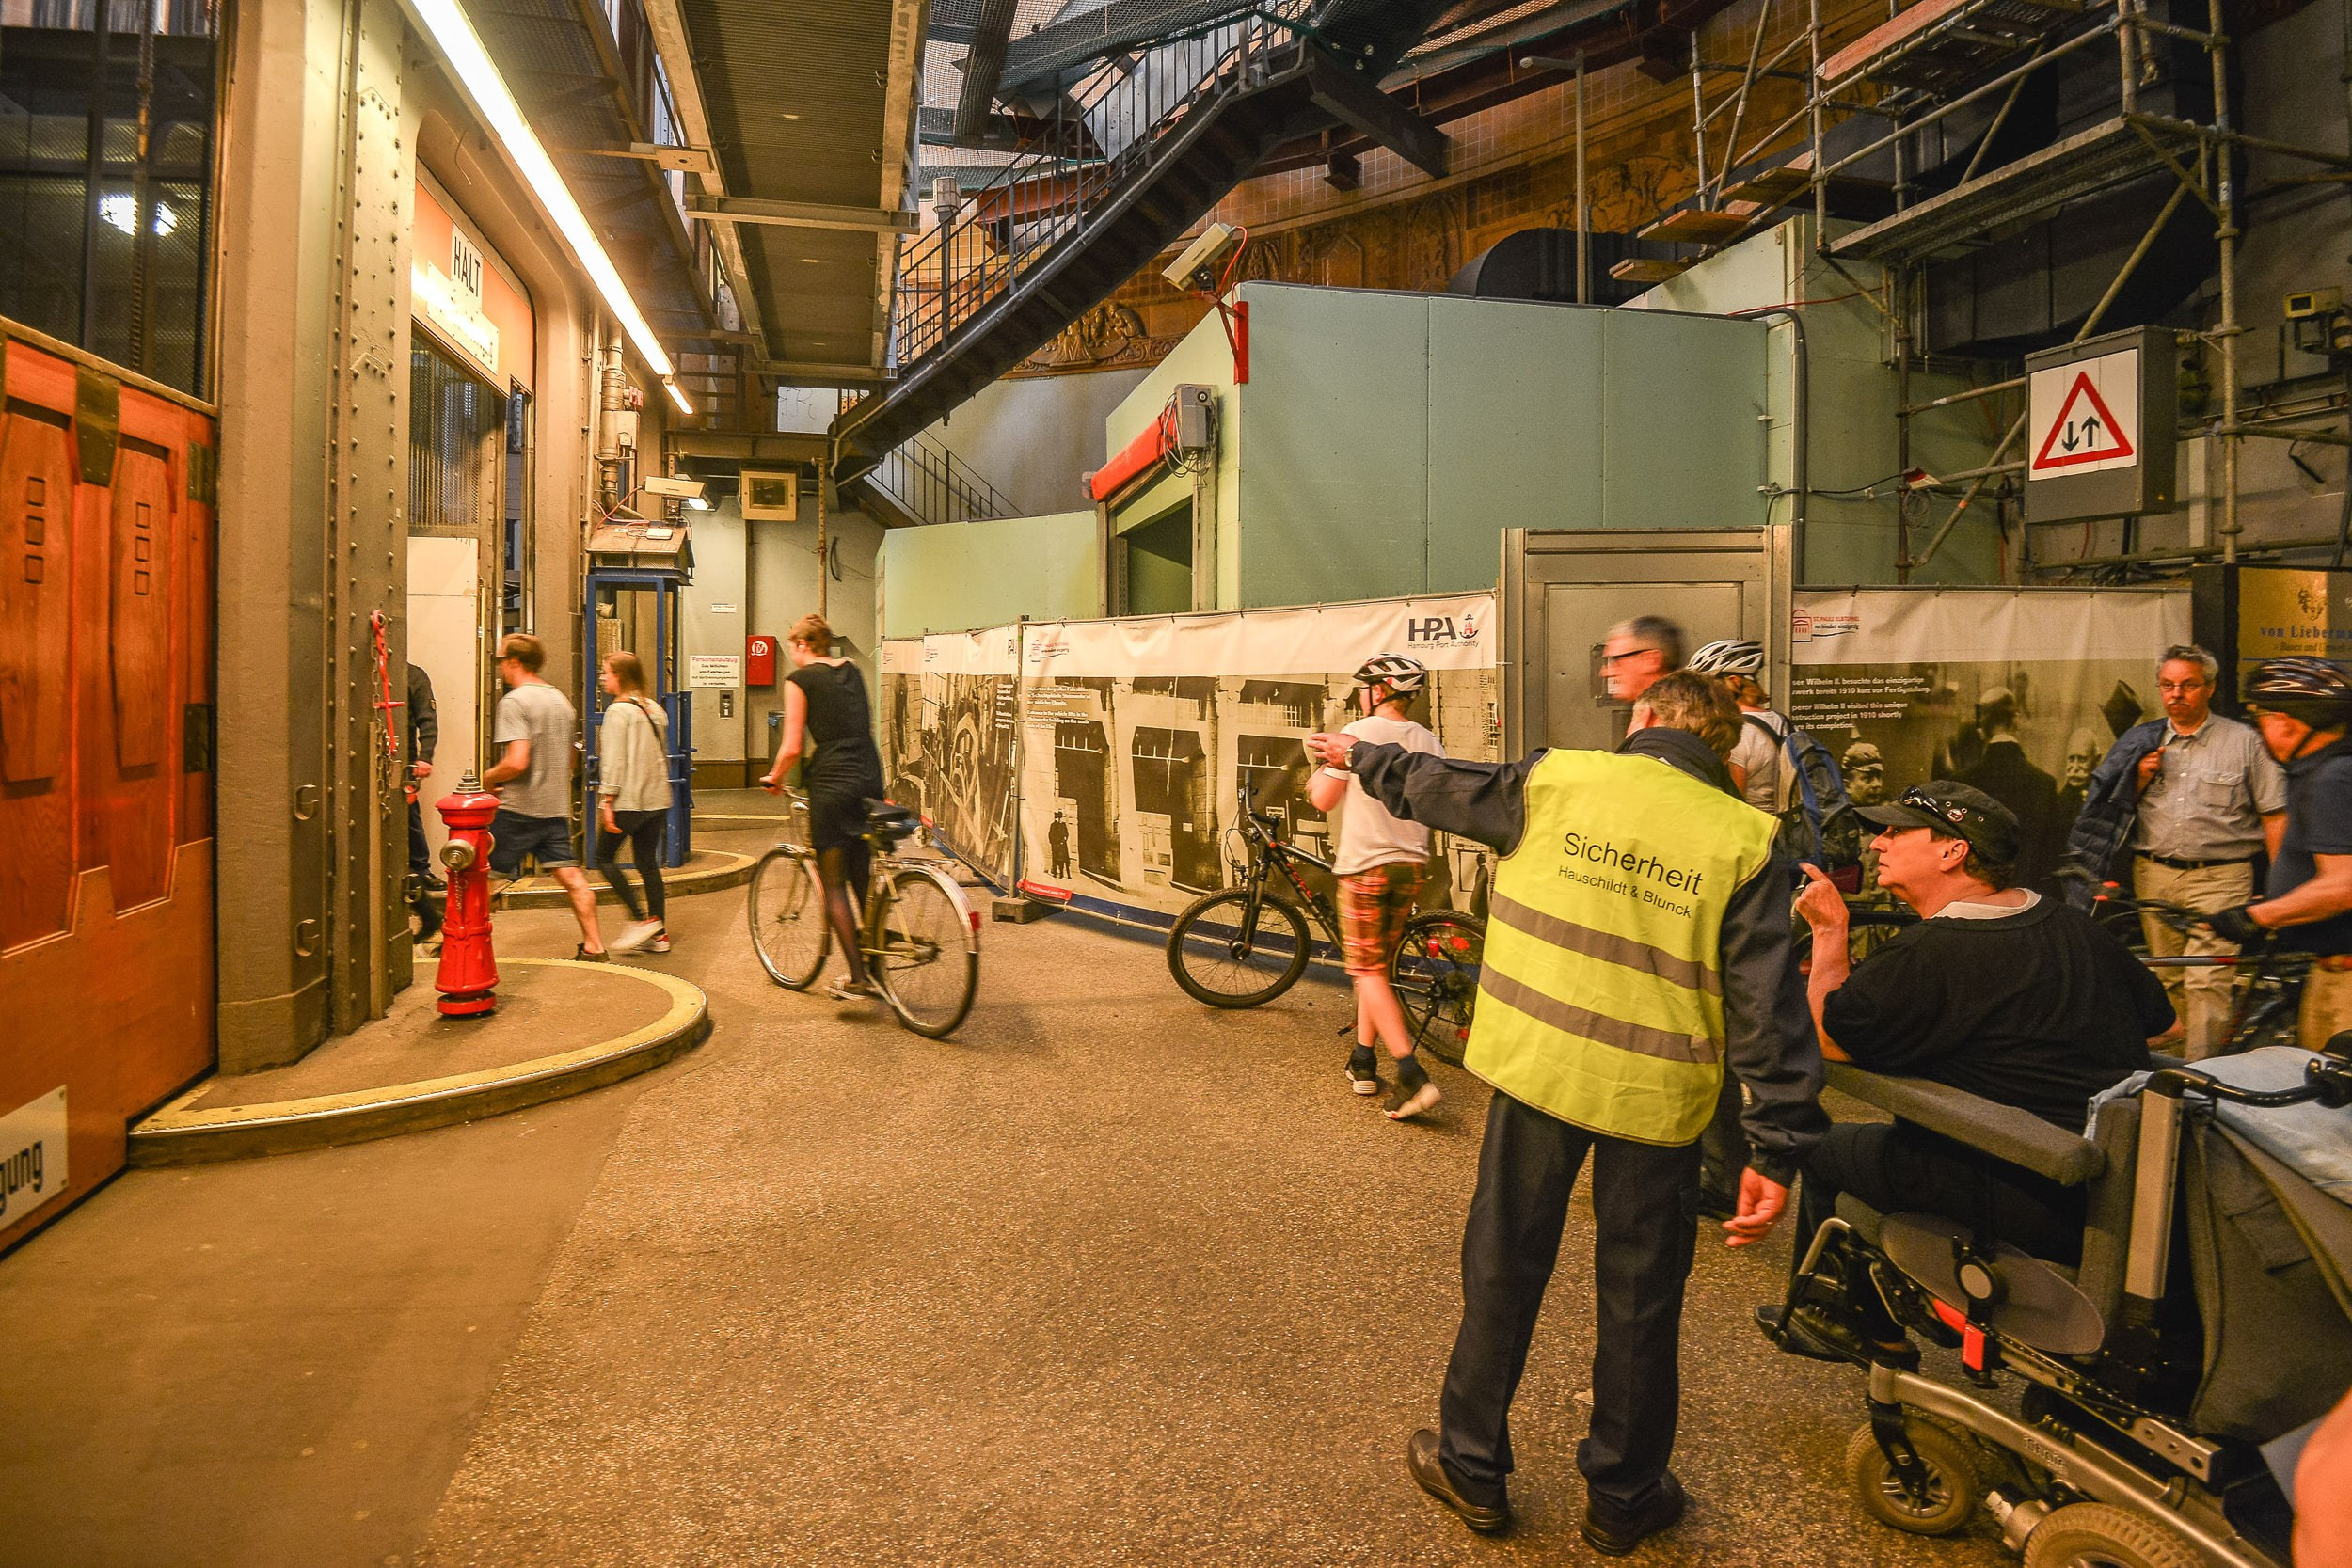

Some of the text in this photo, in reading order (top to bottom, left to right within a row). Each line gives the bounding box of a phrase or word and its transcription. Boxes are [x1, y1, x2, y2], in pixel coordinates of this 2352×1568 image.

[454, 236, 482, 297] HALT
[1408, 617, 1457, 641] HPA
[2260, 626, 2284, 638] von
[1564, 832, 1704, 895] Sicherheit
[1558, 864, 1694, 919] Hauschildt & Blunck
